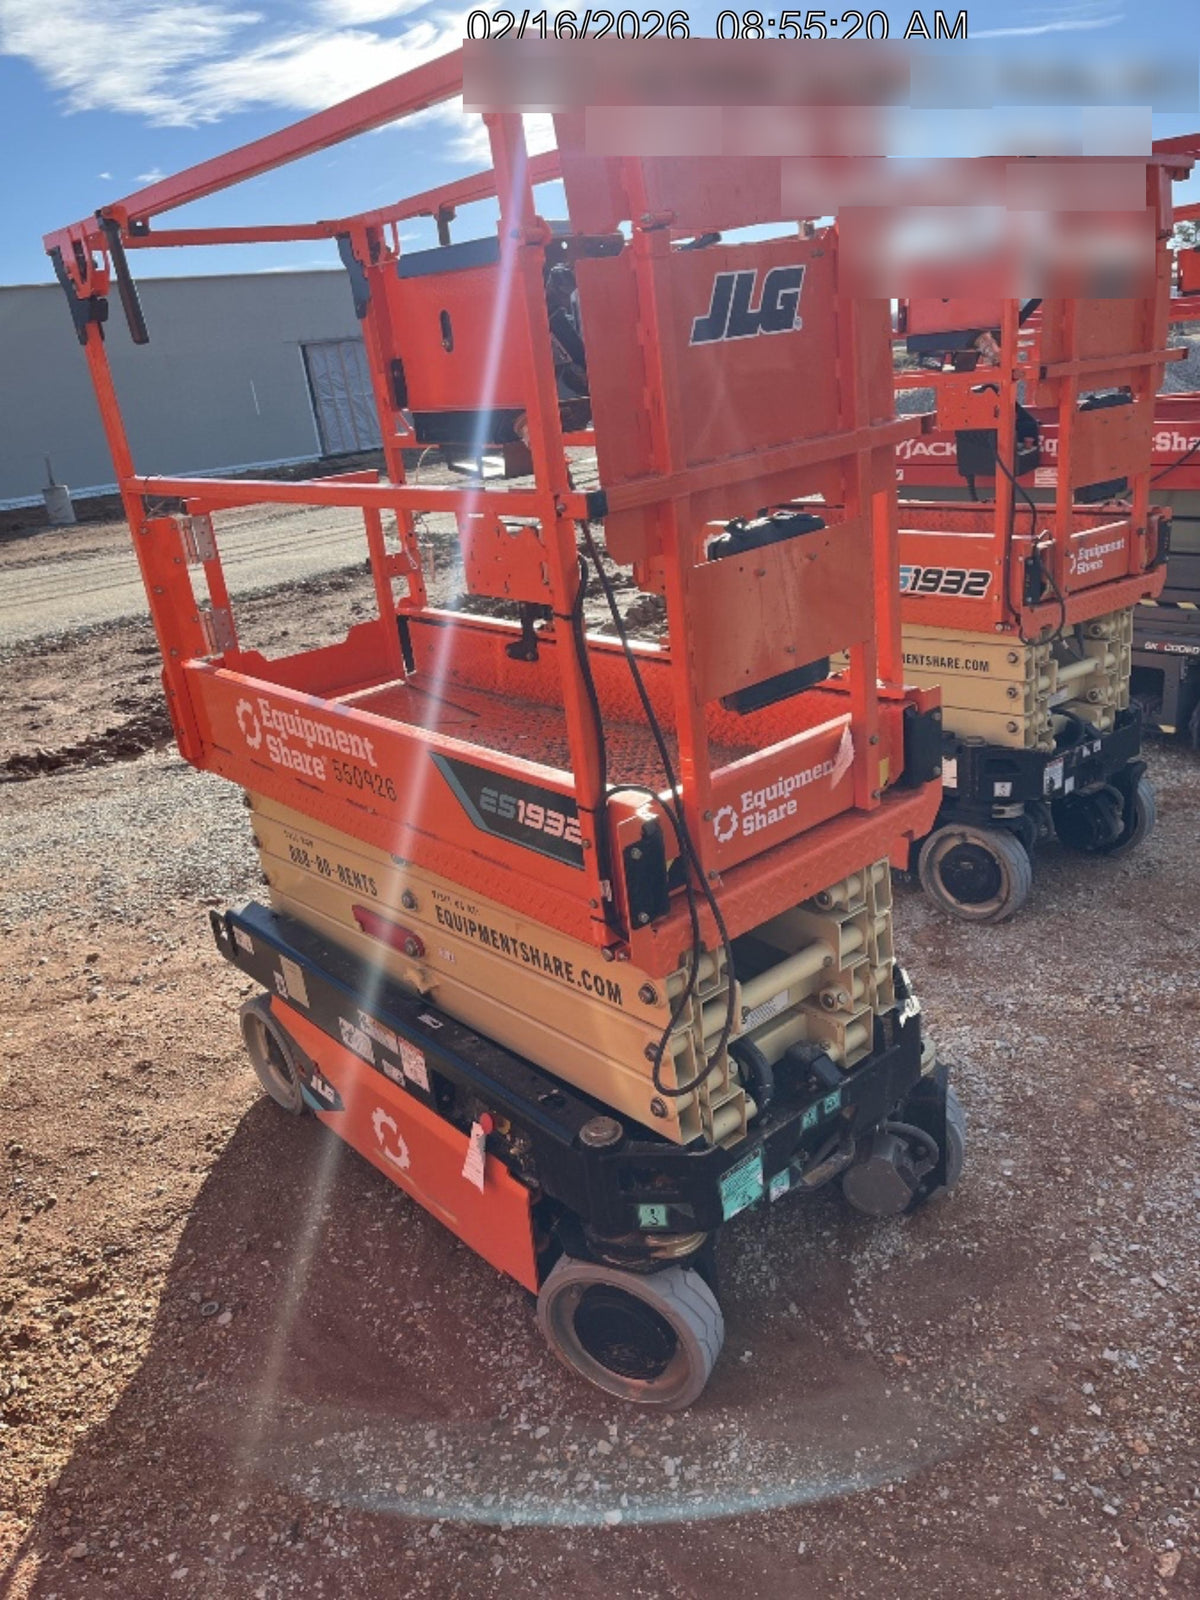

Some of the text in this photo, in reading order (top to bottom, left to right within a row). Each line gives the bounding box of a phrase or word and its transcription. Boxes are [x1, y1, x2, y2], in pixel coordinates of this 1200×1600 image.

[690, 265, 806, 346] JLG
[258, 698, 377, 767] Equipment
[266, 734, 326, 781] Share
[480, 786, 582, 845] ES1932
[741, 760, 835, 813] Equipmen
[742, 799, 798, 836] Share
[434, 904, 623, 1005] EQUIPMENTSHARE.COM
